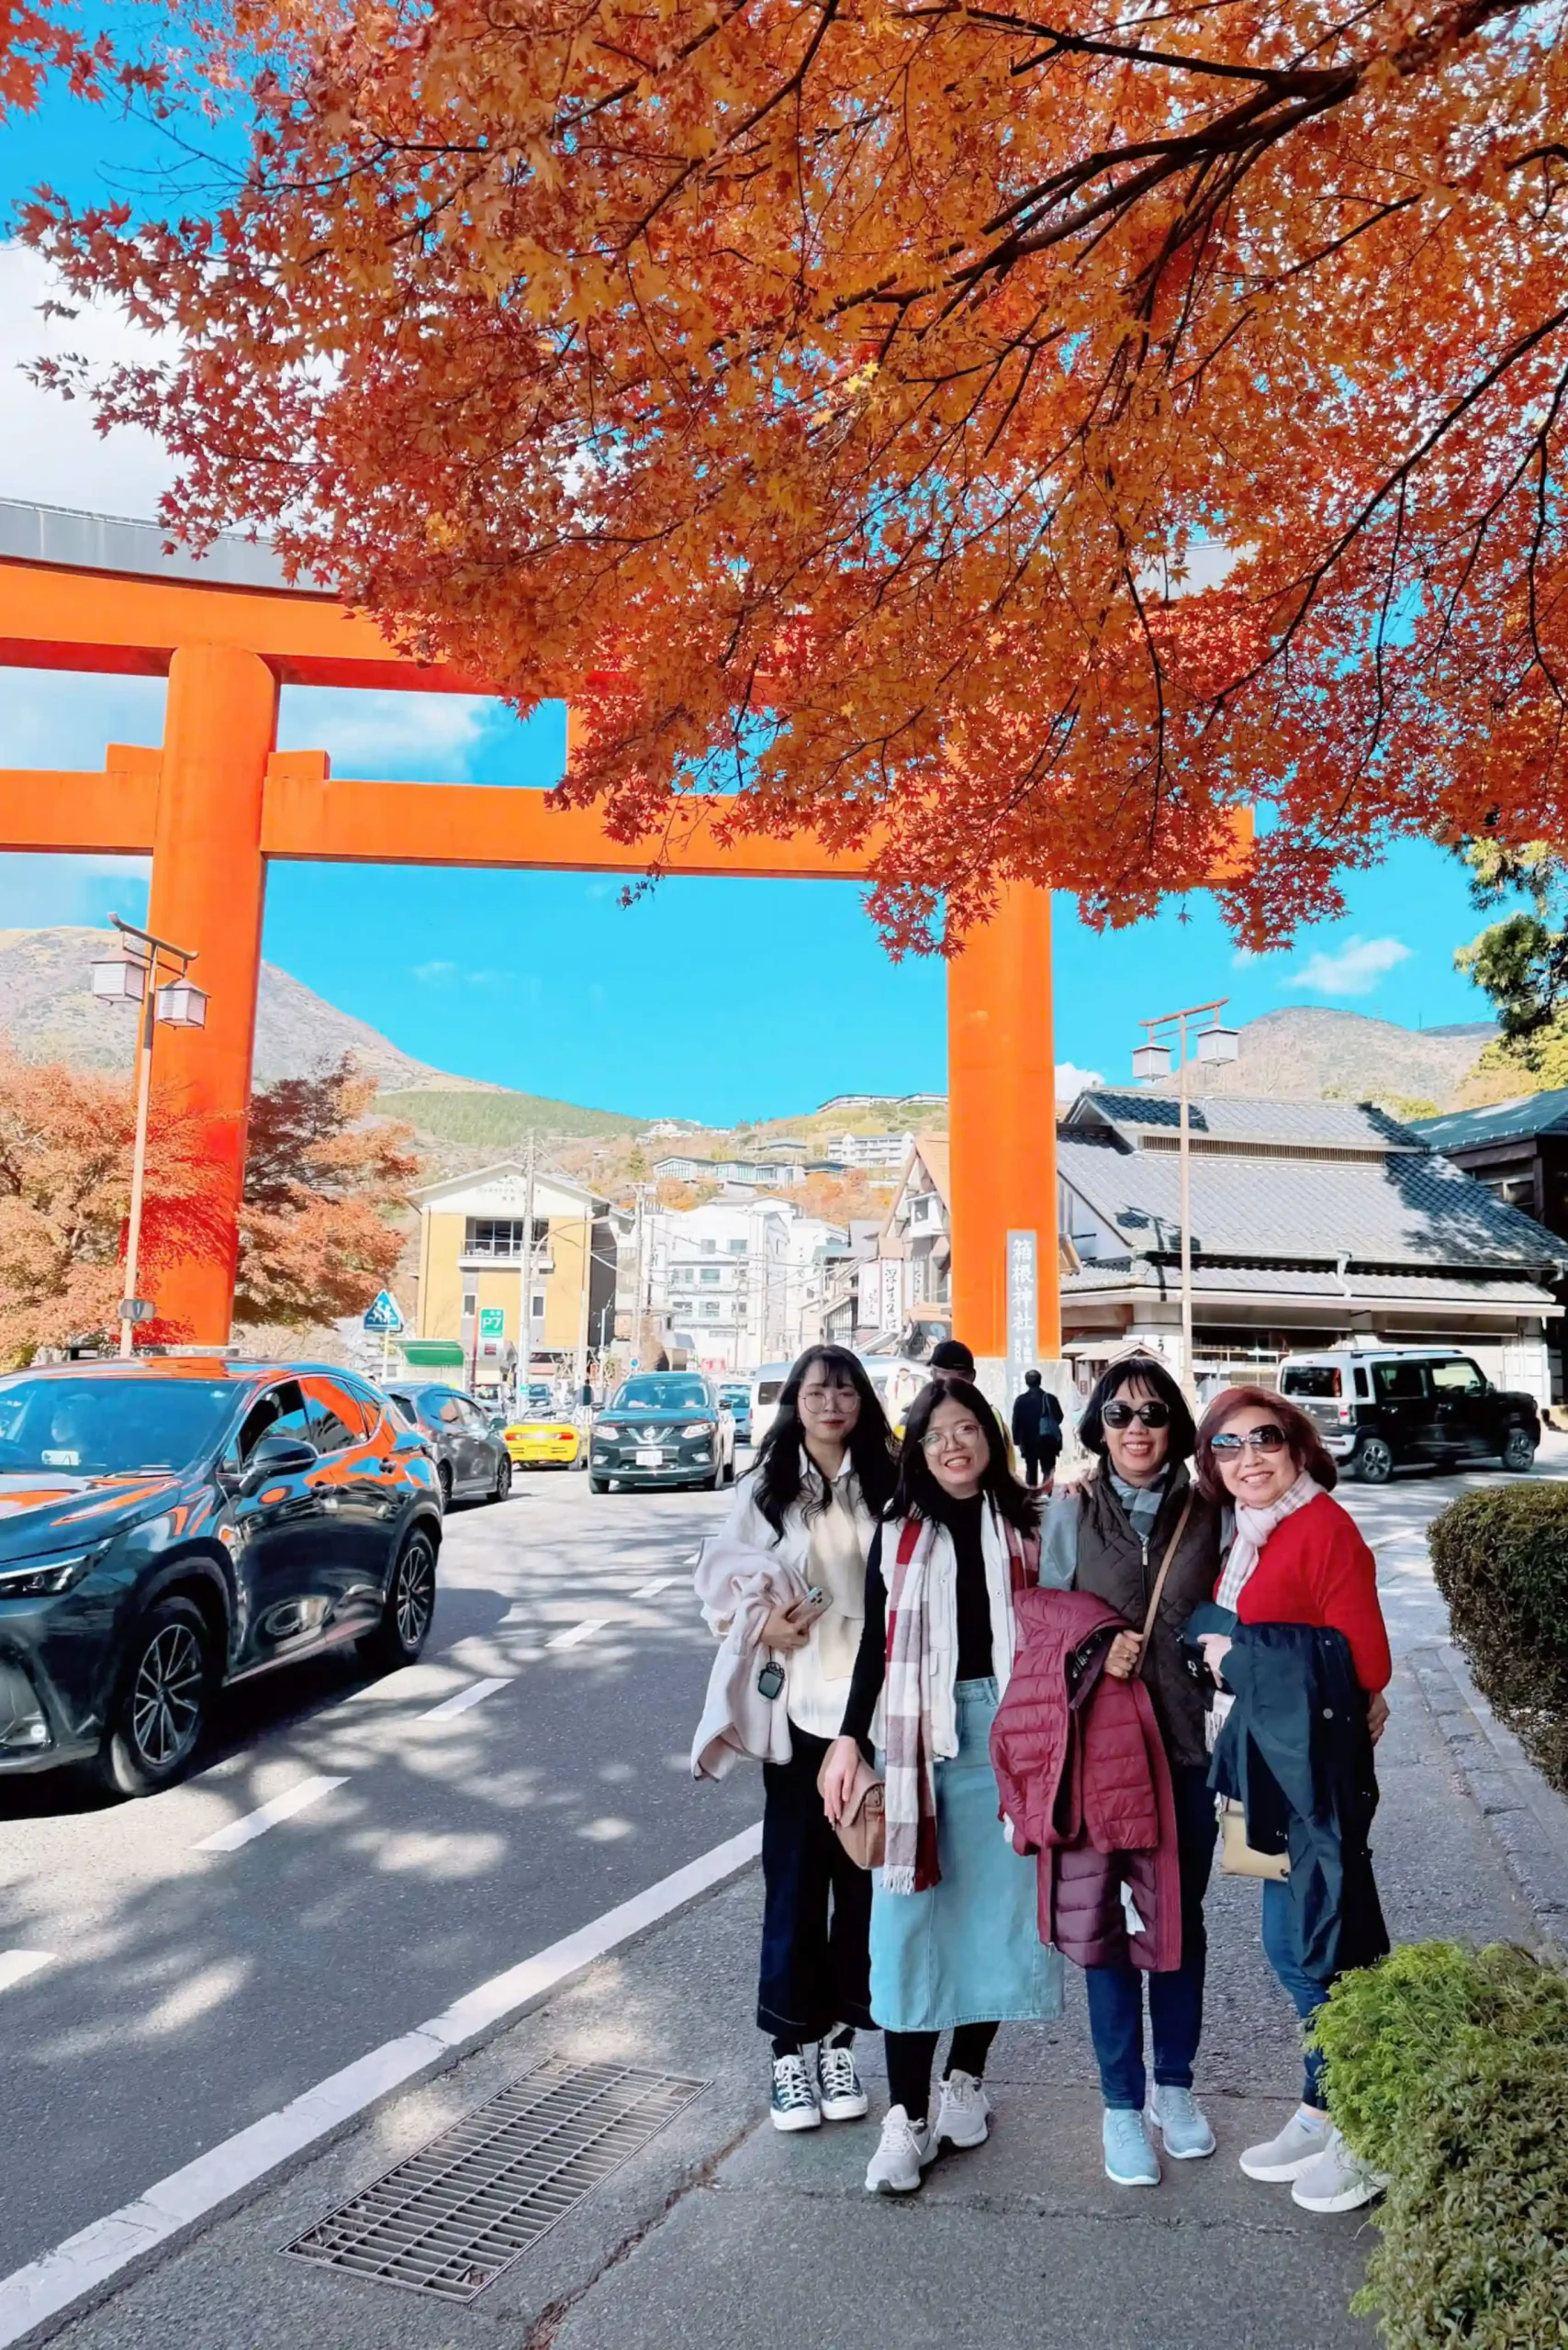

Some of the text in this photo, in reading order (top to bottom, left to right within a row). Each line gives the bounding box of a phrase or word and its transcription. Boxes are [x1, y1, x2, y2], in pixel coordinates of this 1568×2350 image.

[1011, 1238, 1035, 1332] 箱根神社
[483, 1316, 502, 1329] P7
